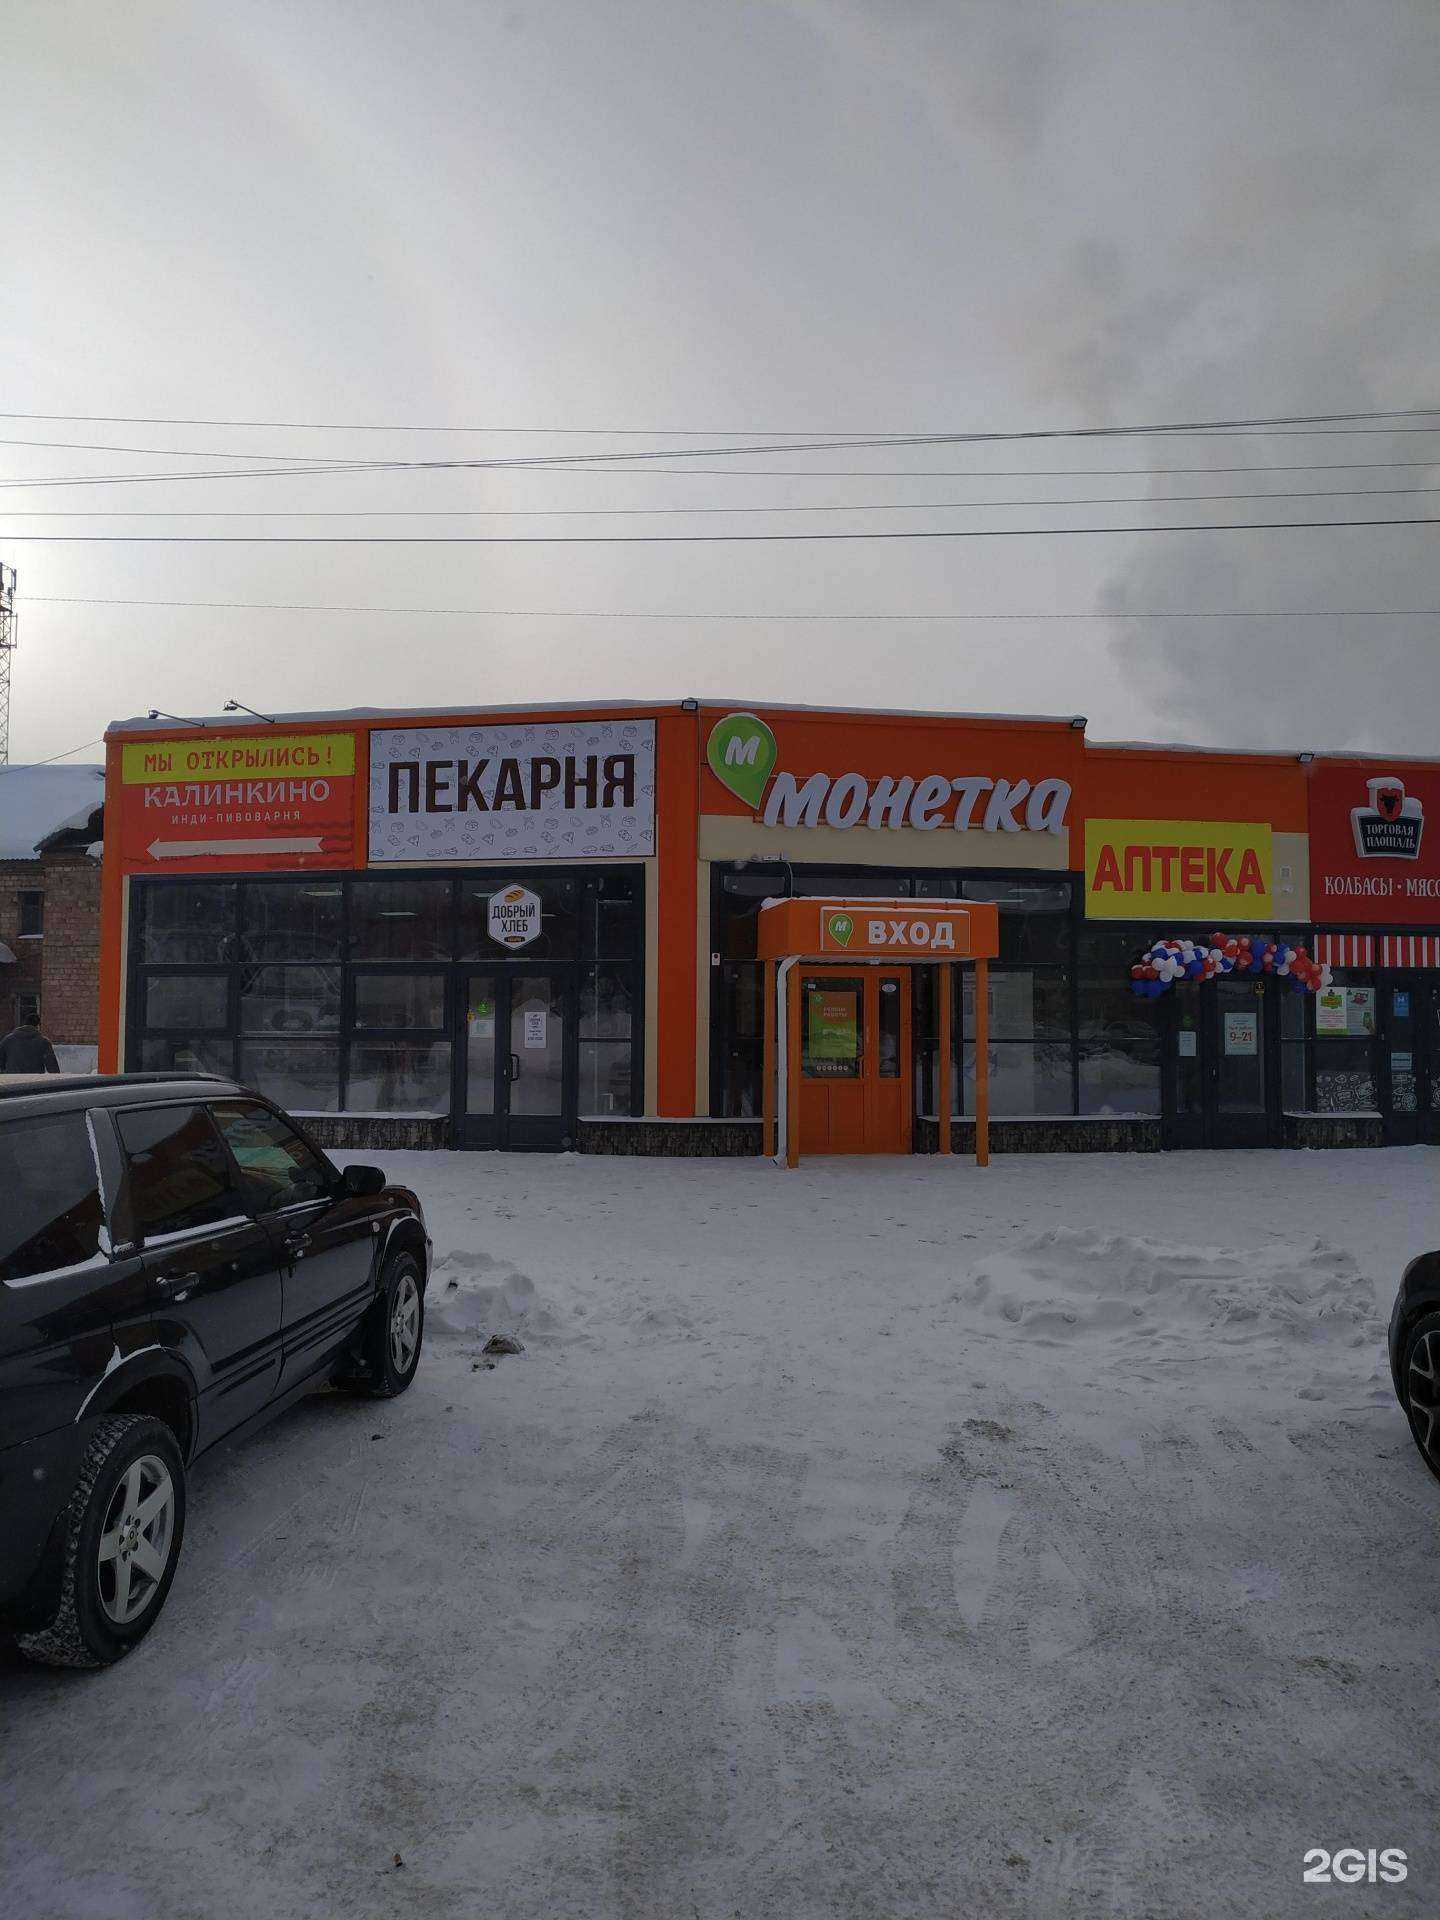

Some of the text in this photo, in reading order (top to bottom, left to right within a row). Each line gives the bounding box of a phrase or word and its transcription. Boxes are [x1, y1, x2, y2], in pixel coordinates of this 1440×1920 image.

[144, 746, 332, 772] МЫ ОТКРЫЛИСЬ!
[144, 779, 330, 808] КАЛИНКИНО
[388, 754, 635, 813] ПЕКАРНЯ
[171, 810, 301, 825] ИНДИ-ПИВОВАРНЯ
[1366, 824, 1414, 836] ТОРГОВАЯ
[1366, 836, 1415, 849] ПЛОЩАДЬ
[1092, 844, 1266, 895] АПТЕКА
[1324, 876, 1393, 897] КОЛБАСЫ
[491, 902, 536, 919] ДОБРЫЙ
[501, 919, 529, 932] ХЛЕБ
[868, 919, 956, 949] ВХОД
